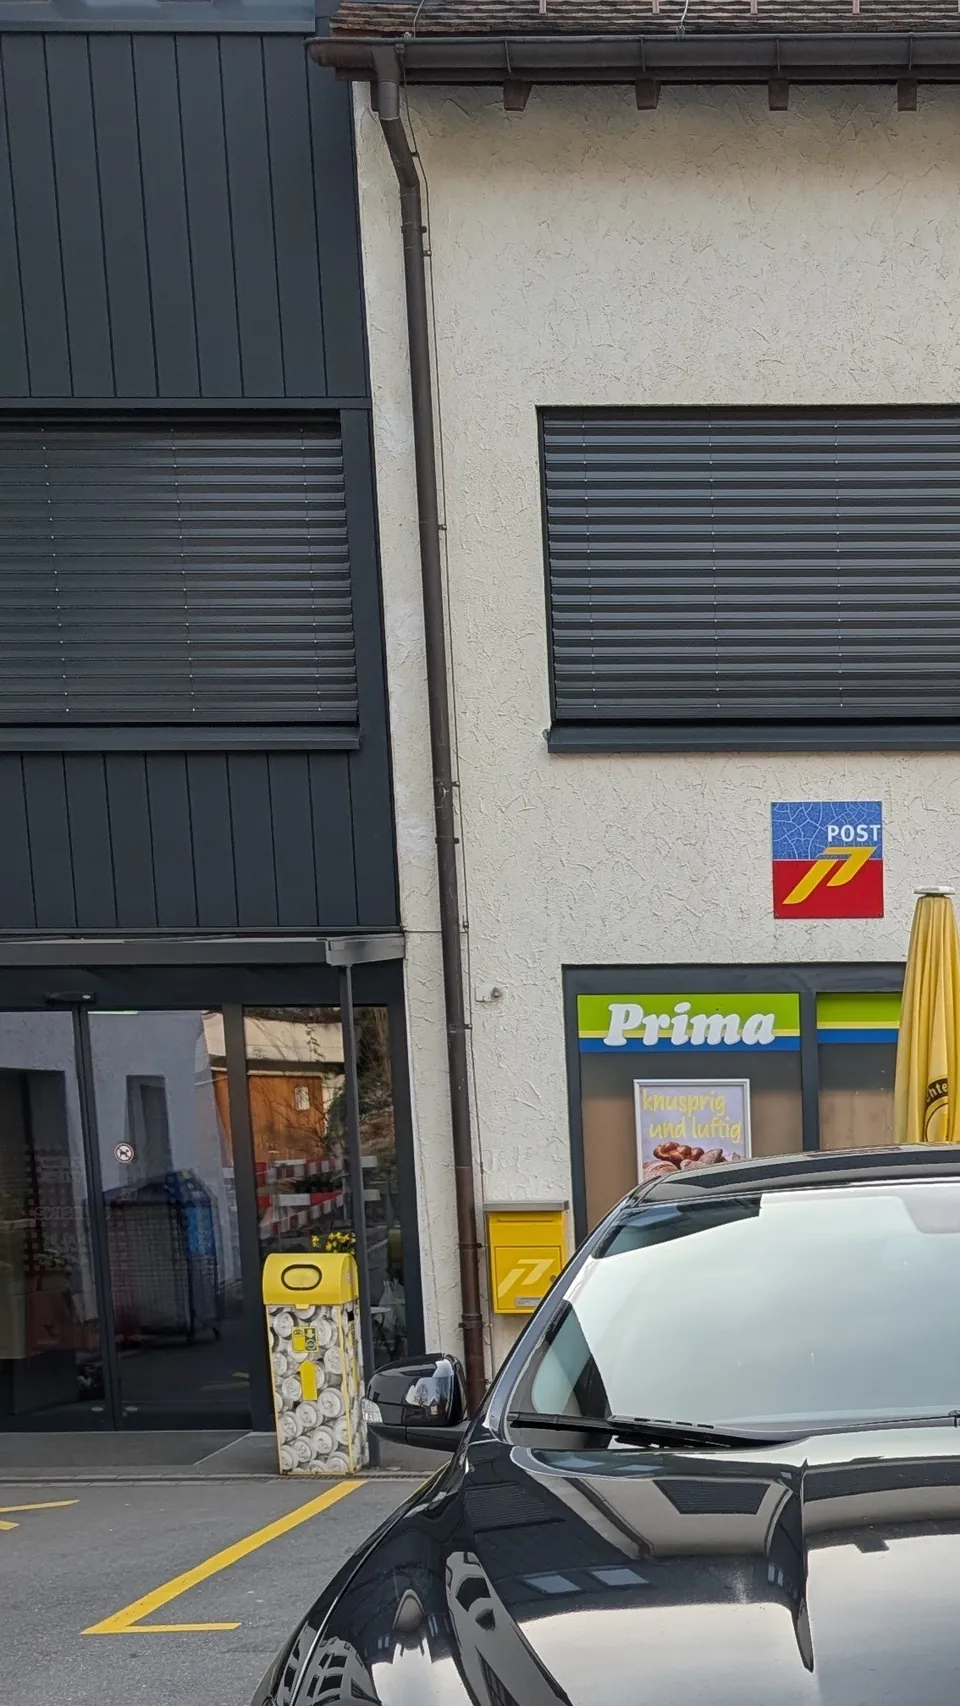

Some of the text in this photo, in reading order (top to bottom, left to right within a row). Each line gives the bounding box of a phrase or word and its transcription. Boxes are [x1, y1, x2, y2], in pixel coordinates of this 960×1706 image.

[826, 823, 882, 843] POST
[602, 1001, 776, 1047] Prima
[641, 1087, 727, 1118] knusprig
[649, 1114, 744, 1145] und luftig
